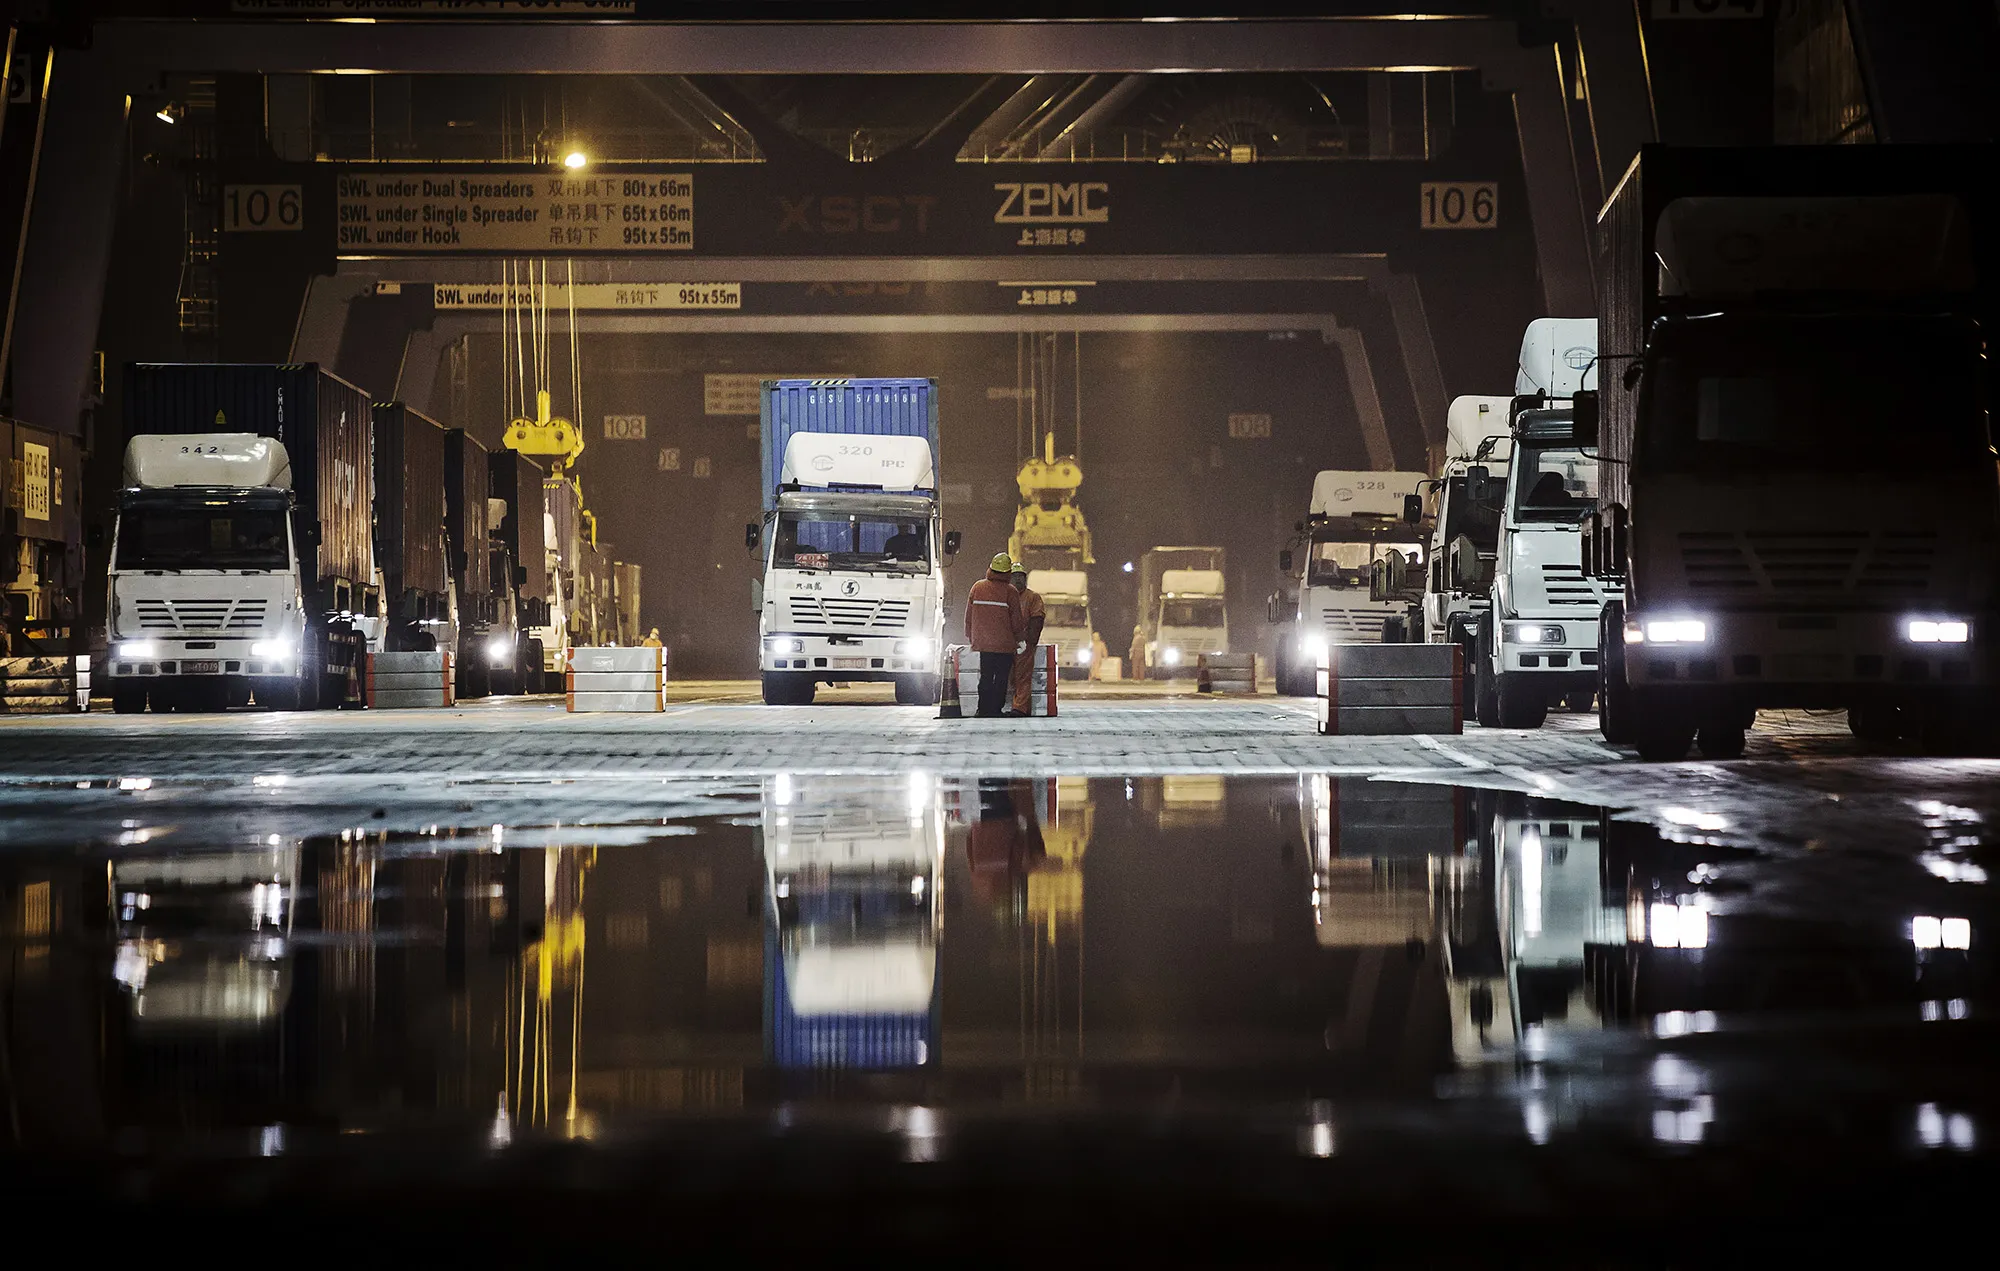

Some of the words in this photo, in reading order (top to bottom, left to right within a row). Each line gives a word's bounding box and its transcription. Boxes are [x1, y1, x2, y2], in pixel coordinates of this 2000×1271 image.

[340, 180, 372, 197] SWL
[376, 180, 419, 197] under
[423, 180, 455, 197] Dual
[459, 180, 535, 202] Spreaders
[227, 189, 299, 227] 106
[994, 182, 1110, 223] ZPMC
[1423, 187, 1493, 223] 106
[340, 205, 372, 222] SWL
[376, 205, 419, 222] under
[422, 205, 468, 226] Single
[472, 205, 540, 227] Spreader
[776, 193, 938, 234] XSCT
[340, 227, 372, 244] SWL
[376, 227, 419, 244] under
[422, 227, 461, 244] Hook
[436, 289, 464, 304] SWL
[467, 289, 504, 304] under
[809, 393, 843, 405] GESU
[606, 417, 643, 438] 108
[180, 446, 218, 454] 342
[838, 445, 873, 456] 320
[881, 459, 905, 468] IPC
[1356, 481, 1386, 491] 328
